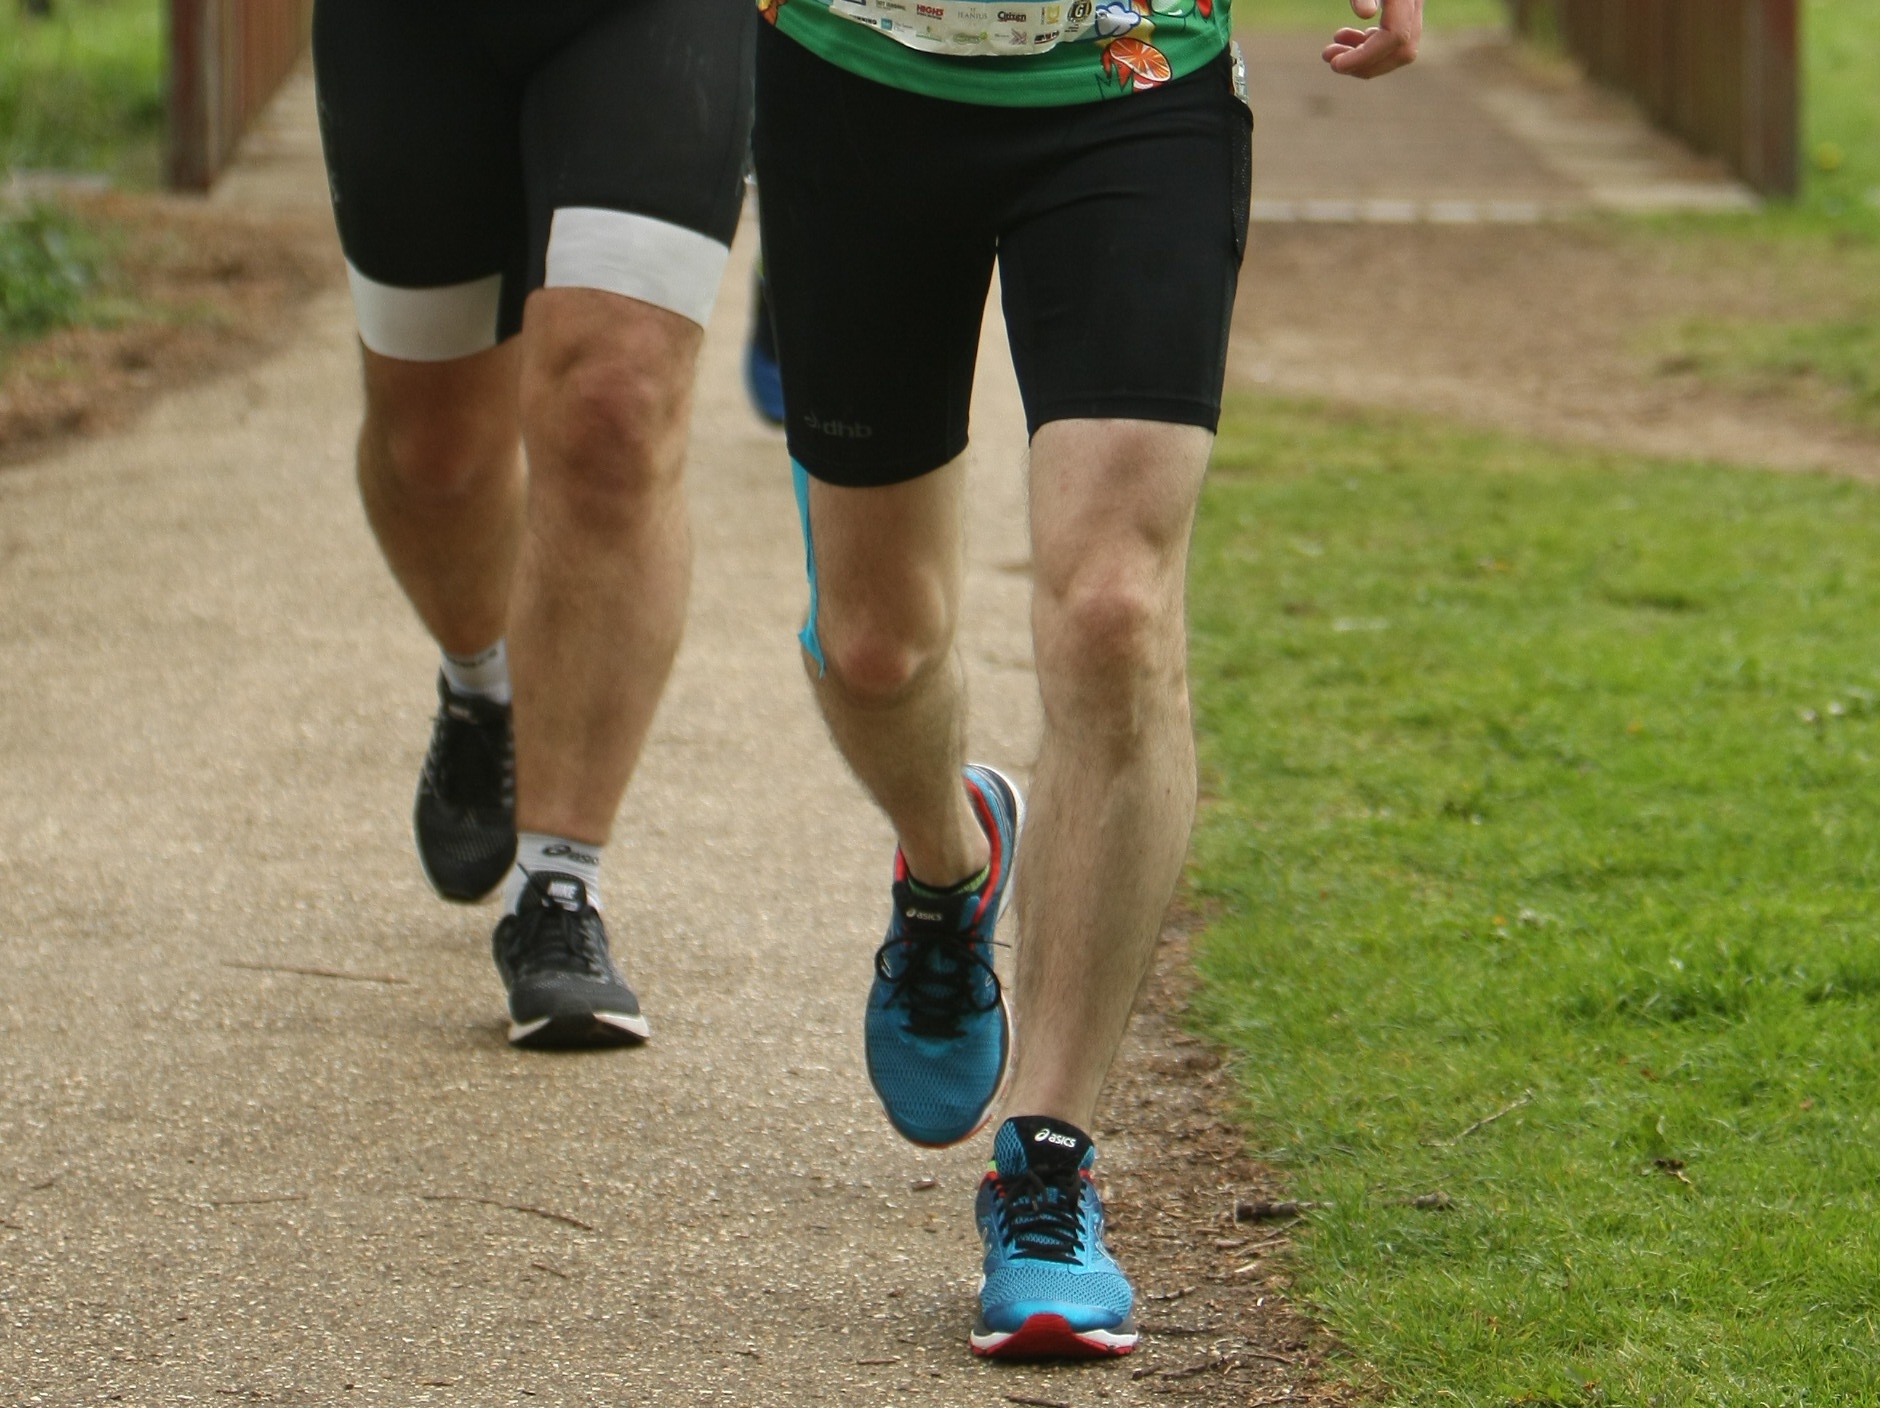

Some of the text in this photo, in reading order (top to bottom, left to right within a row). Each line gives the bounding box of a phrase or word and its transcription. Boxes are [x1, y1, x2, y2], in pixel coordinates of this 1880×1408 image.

[823, 420, 873, 439] dhb
[916, 910, 943, 922] asics
[1048, 1132, 1077, 1148] asics
